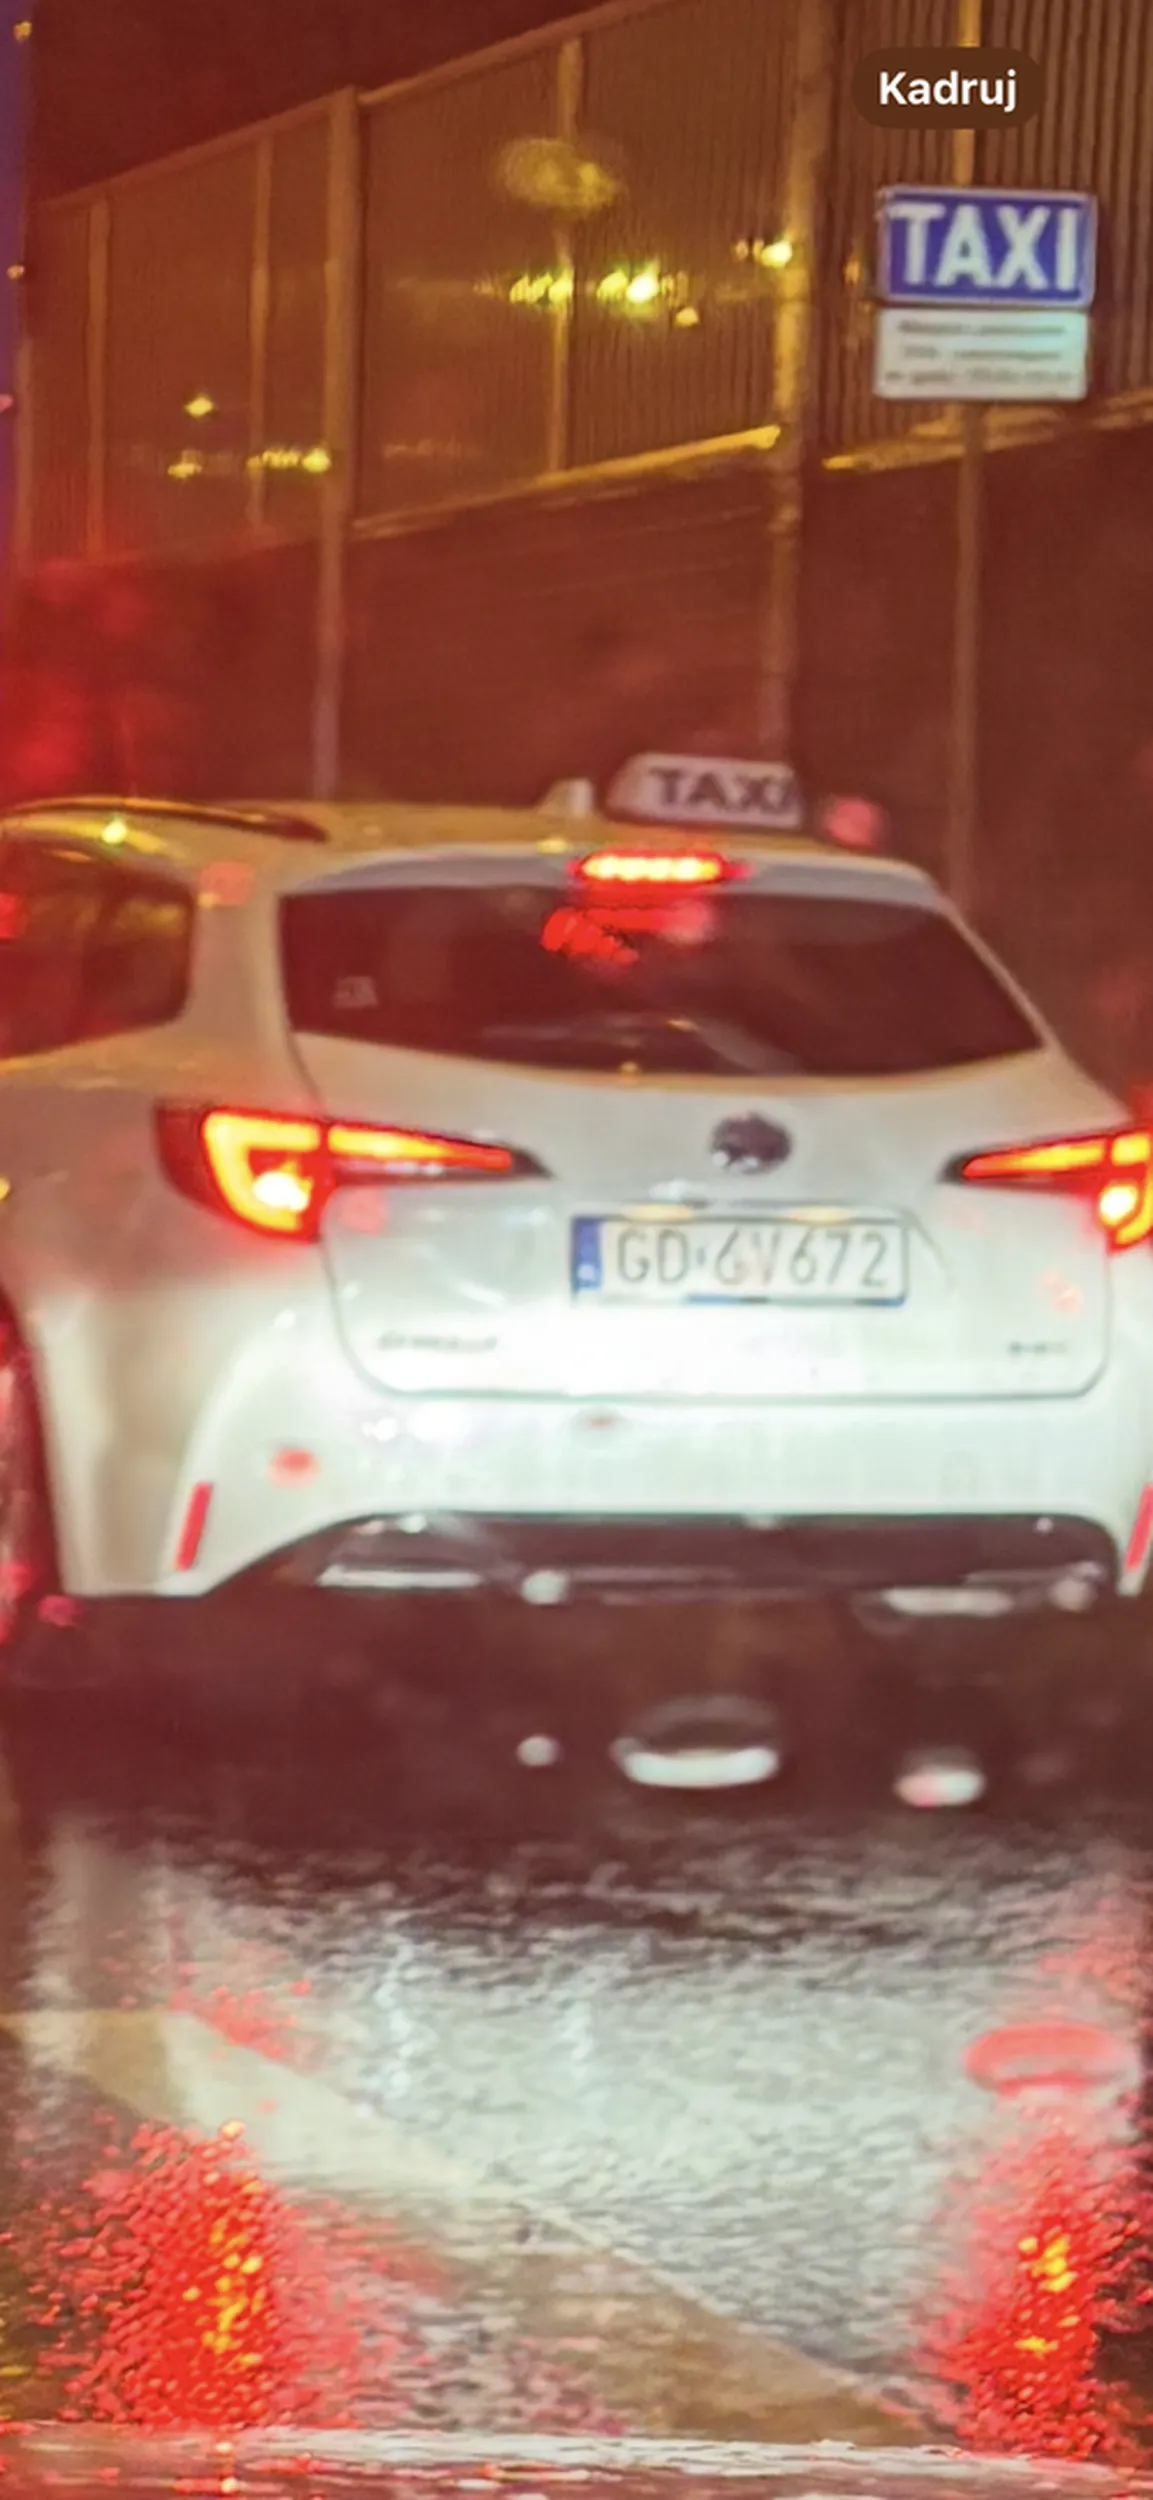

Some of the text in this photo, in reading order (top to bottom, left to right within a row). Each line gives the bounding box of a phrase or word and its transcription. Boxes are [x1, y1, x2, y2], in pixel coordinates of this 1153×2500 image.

[886, 202, 1080, 291] TAXI
[616, 1227, 889, 1288] GD 6V672
